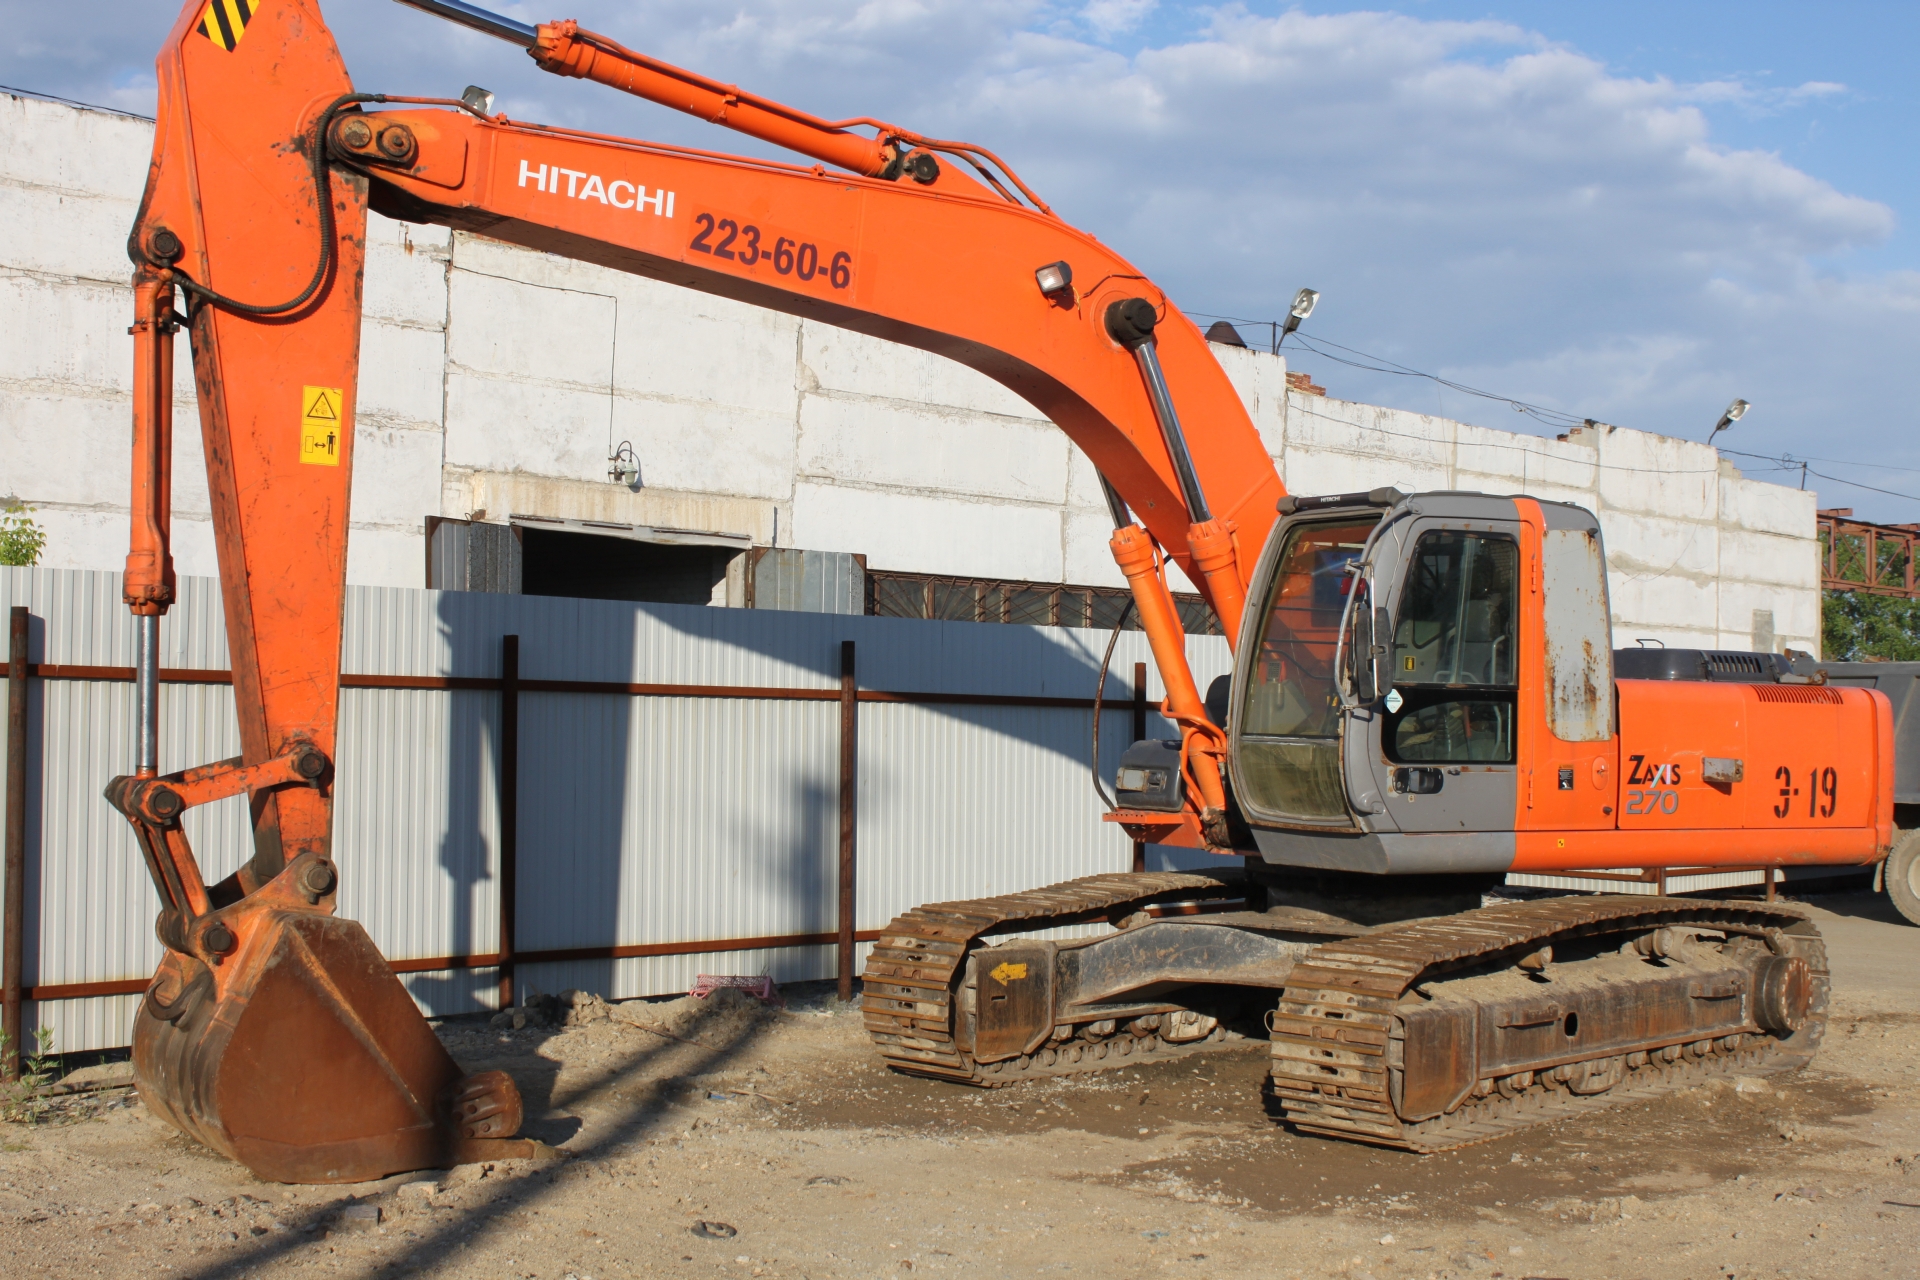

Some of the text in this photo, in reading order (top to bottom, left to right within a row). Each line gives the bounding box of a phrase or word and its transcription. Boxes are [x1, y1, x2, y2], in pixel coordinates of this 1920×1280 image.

[518, 159, 675, 218] HITACHI
[690, 212, 852, 289] 223-60-6
[1626, 790, 1679, 815] 270
